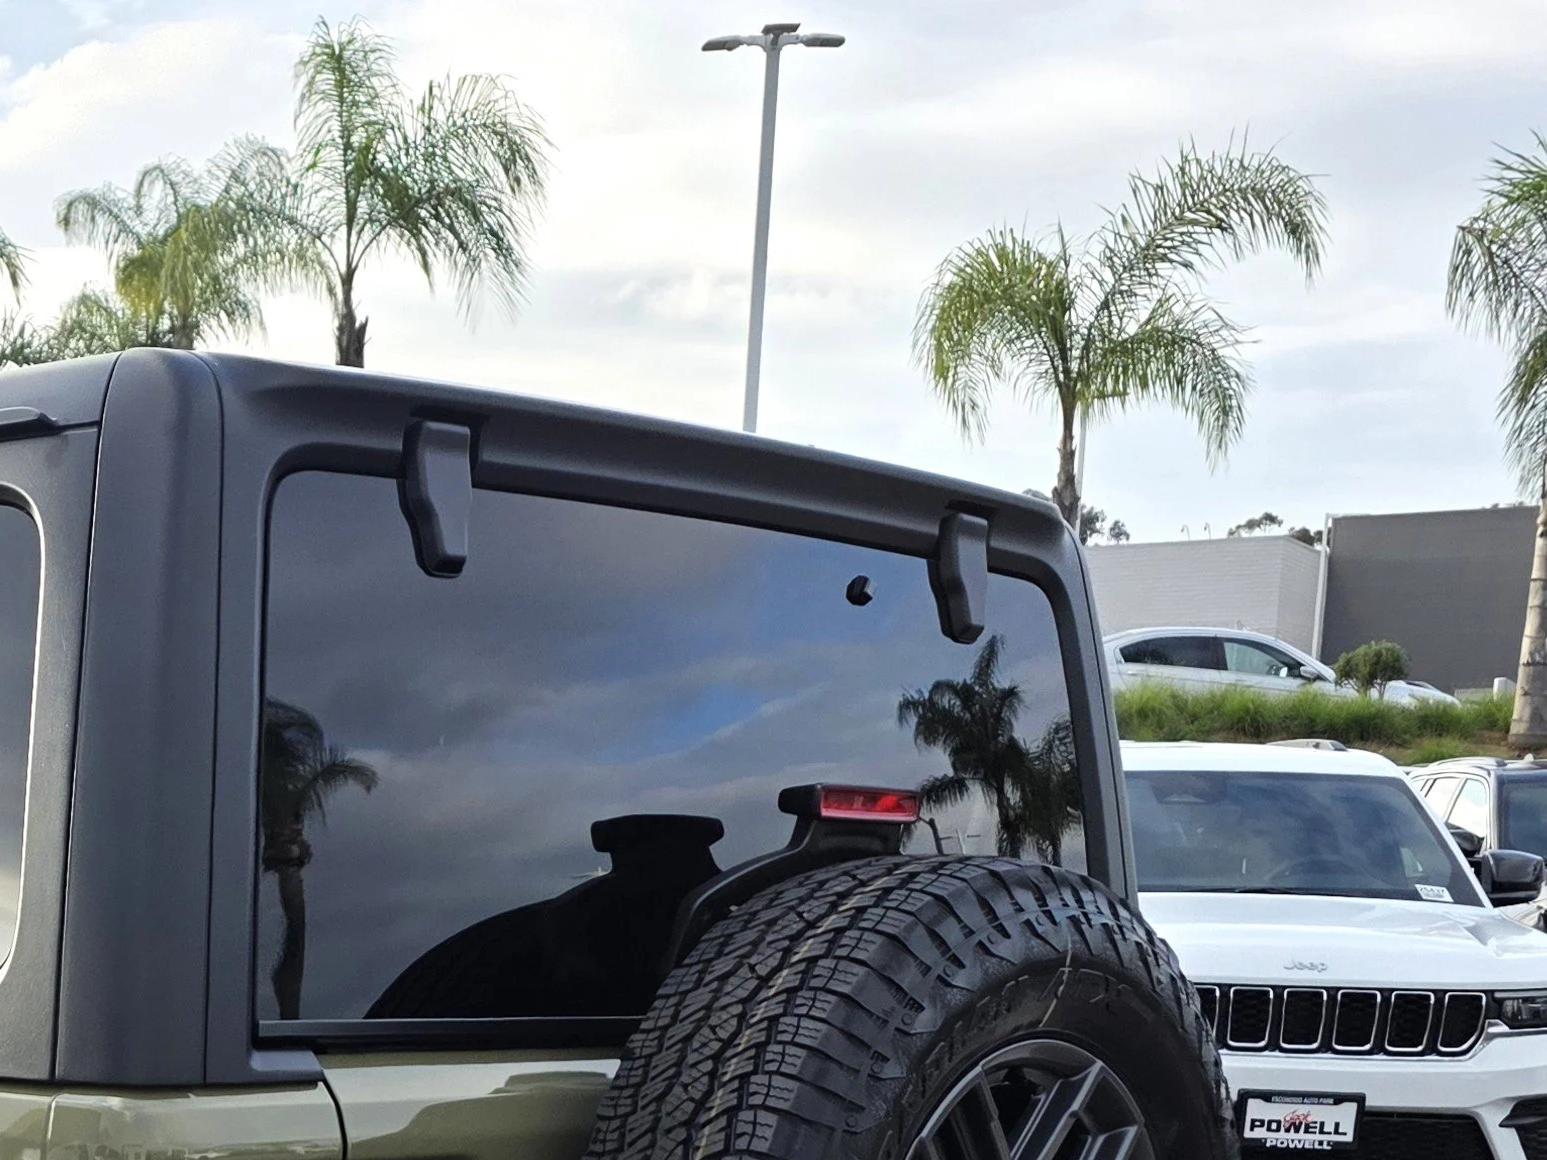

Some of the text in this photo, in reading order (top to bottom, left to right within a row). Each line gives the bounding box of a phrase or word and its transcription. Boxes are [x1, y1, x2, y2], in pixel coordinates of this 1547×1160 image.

[1283, 958, 1328, 973] Jeep
[1249, 1118, 1348, 1136] POWELL
[1265, 1138, 1333, 1150] POWELL
